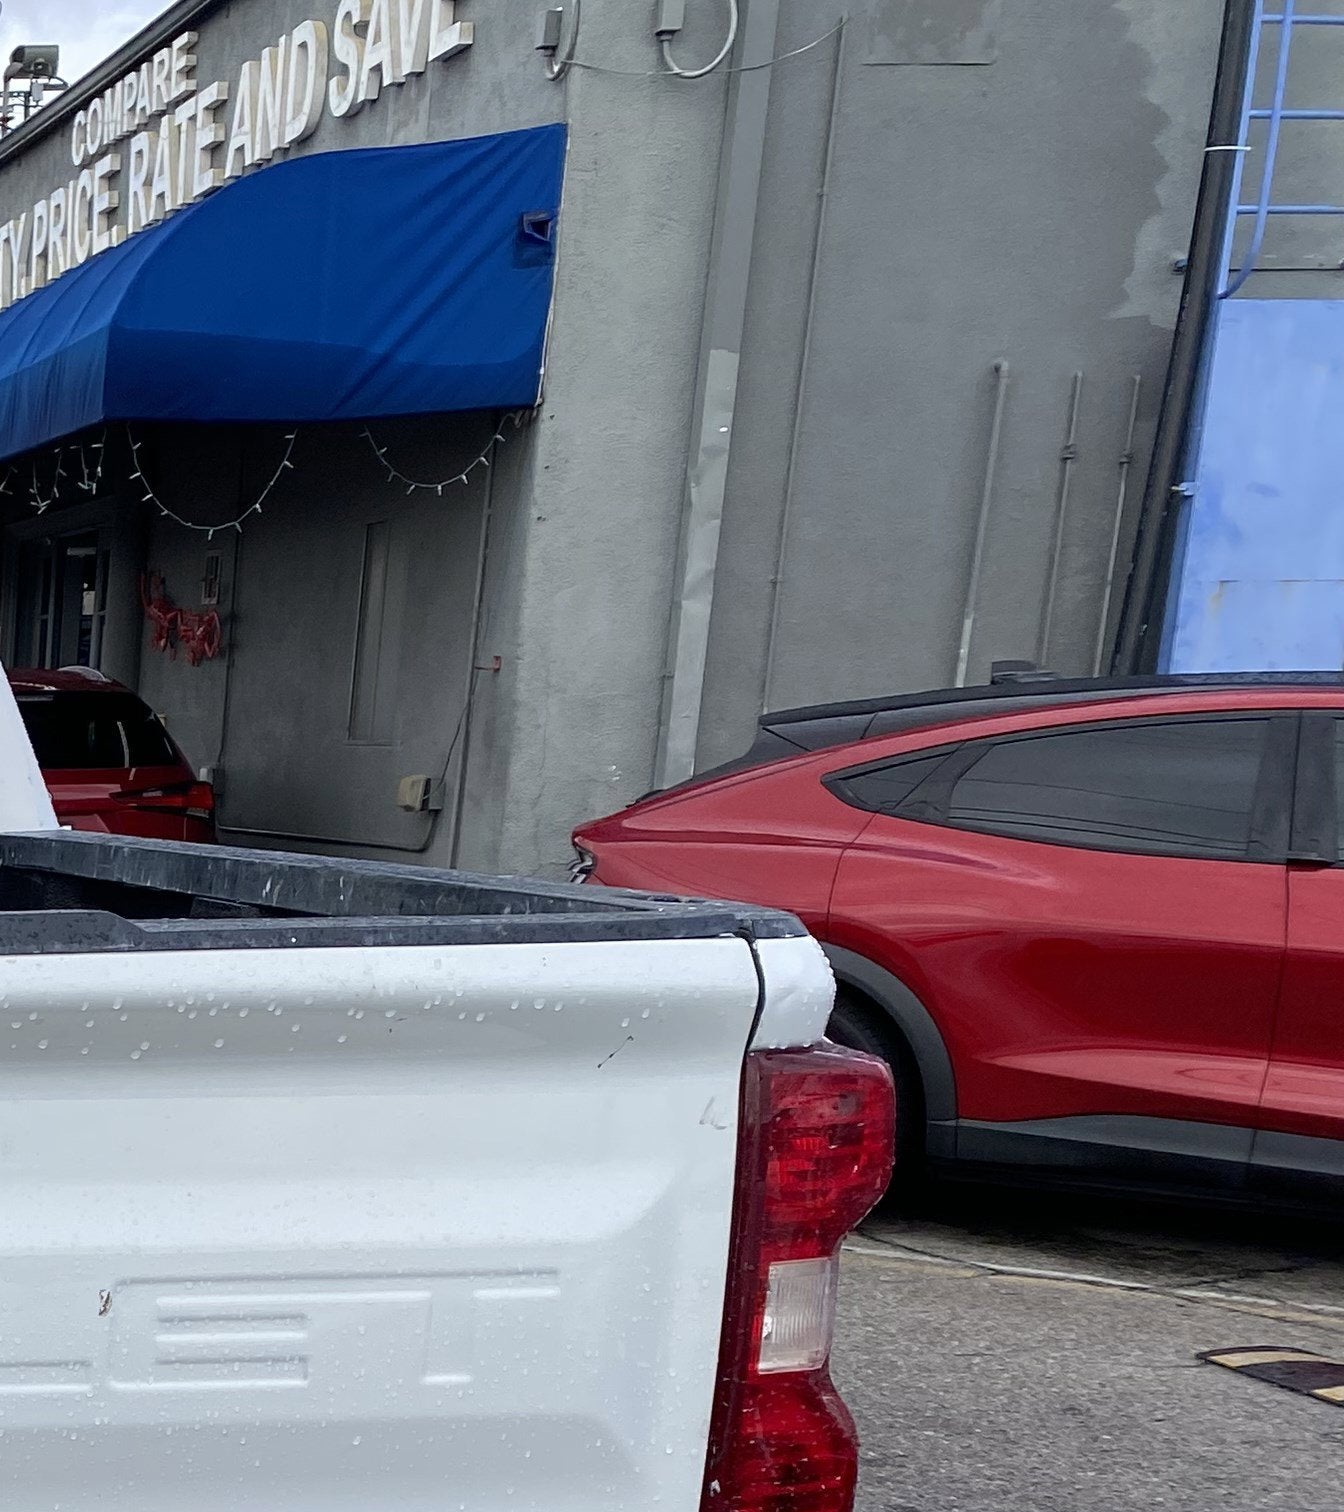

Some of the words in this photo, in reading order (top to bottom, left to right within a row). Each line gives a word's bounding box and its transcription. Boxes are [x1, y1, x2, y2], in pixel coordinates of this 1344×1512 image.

[72, 31, 199, 166] COMPARE
[128, 81, 229, 234] RATE
[225, 19, 329, 179] AND
